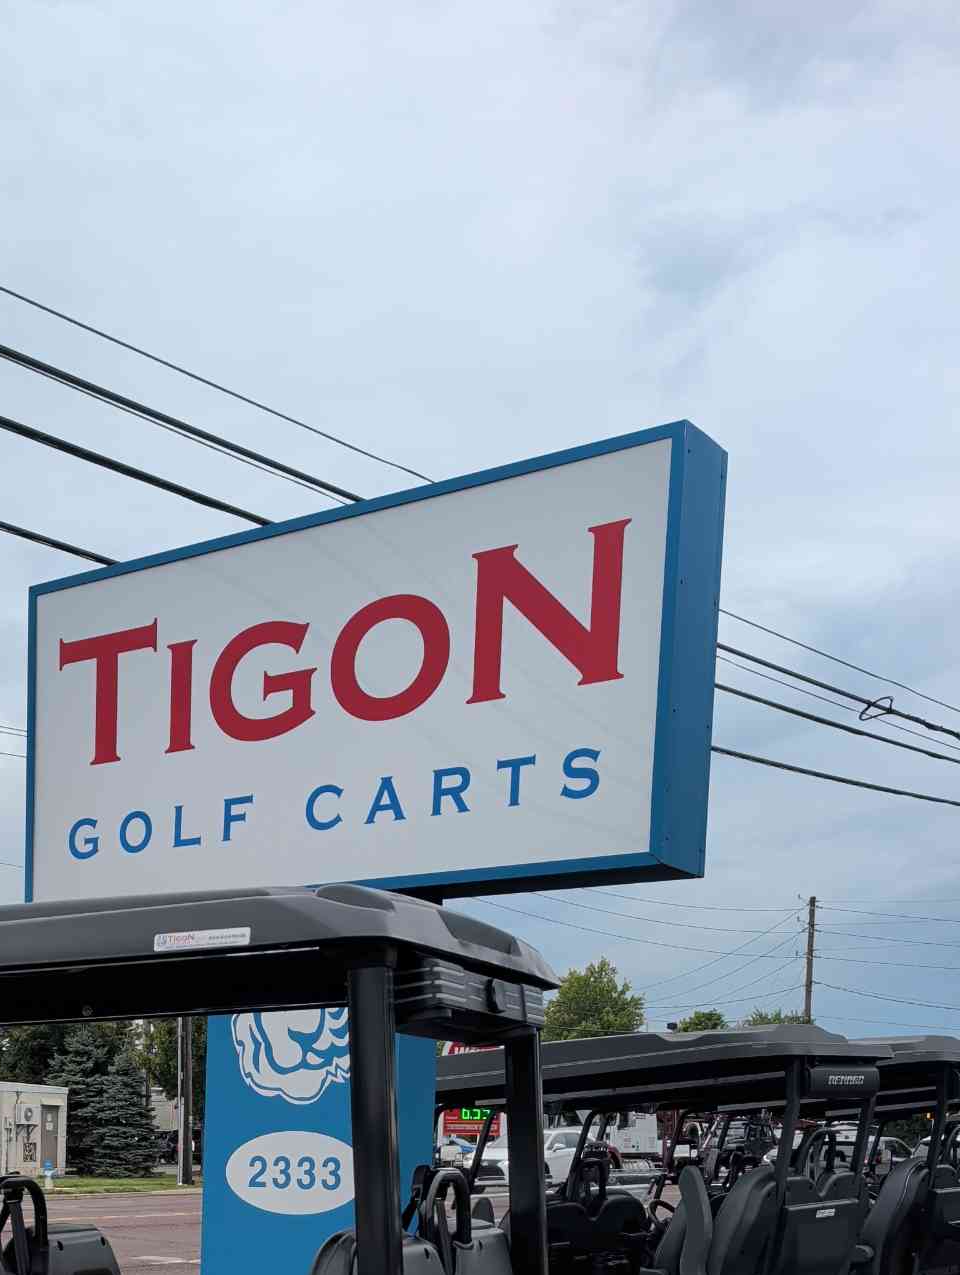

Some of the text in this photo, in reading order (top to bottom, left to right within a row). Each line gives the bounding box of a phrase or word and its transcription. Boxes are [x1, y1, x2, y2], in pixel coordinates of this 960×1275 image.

[58, 518, 633, 765] TIGON
[68, 747, 603, 860] GOLF CARTS
[248, 1155, 342, 1191] 2333
